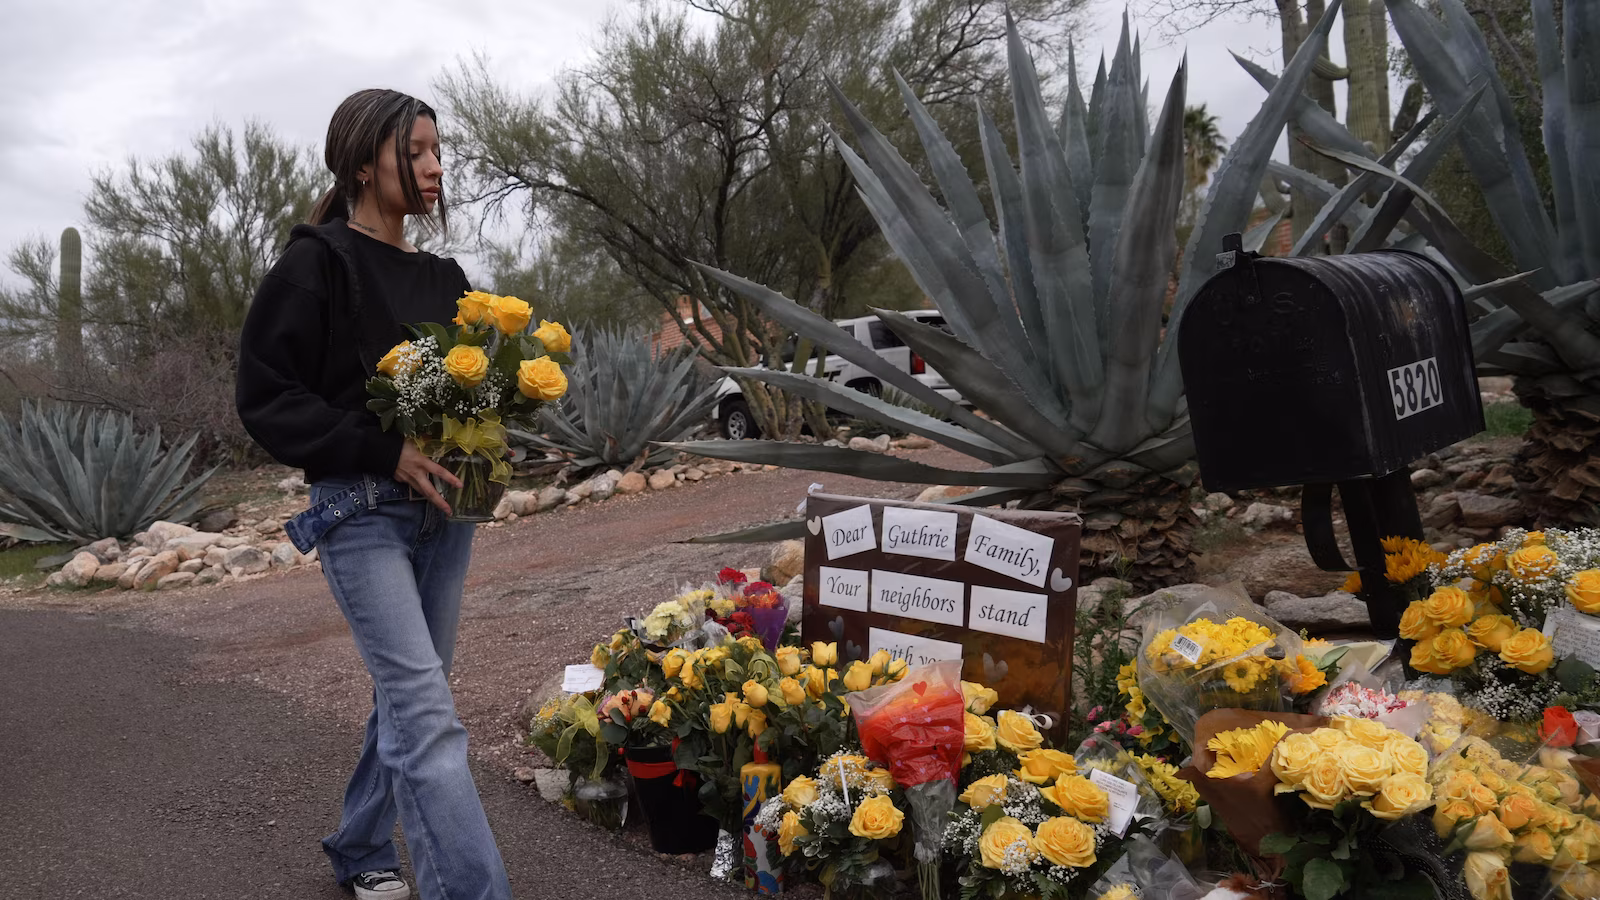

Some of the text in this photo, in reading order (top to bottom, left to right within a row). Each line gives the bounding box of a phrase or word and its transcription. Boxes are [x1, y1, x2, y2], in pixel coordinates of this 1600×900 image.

[1392, 360, 1440, 416] 5820
[832, 524, 1041, 576] Dear Guthrie Family,
[826, 576, 1036, 628] Your neighbors stand
